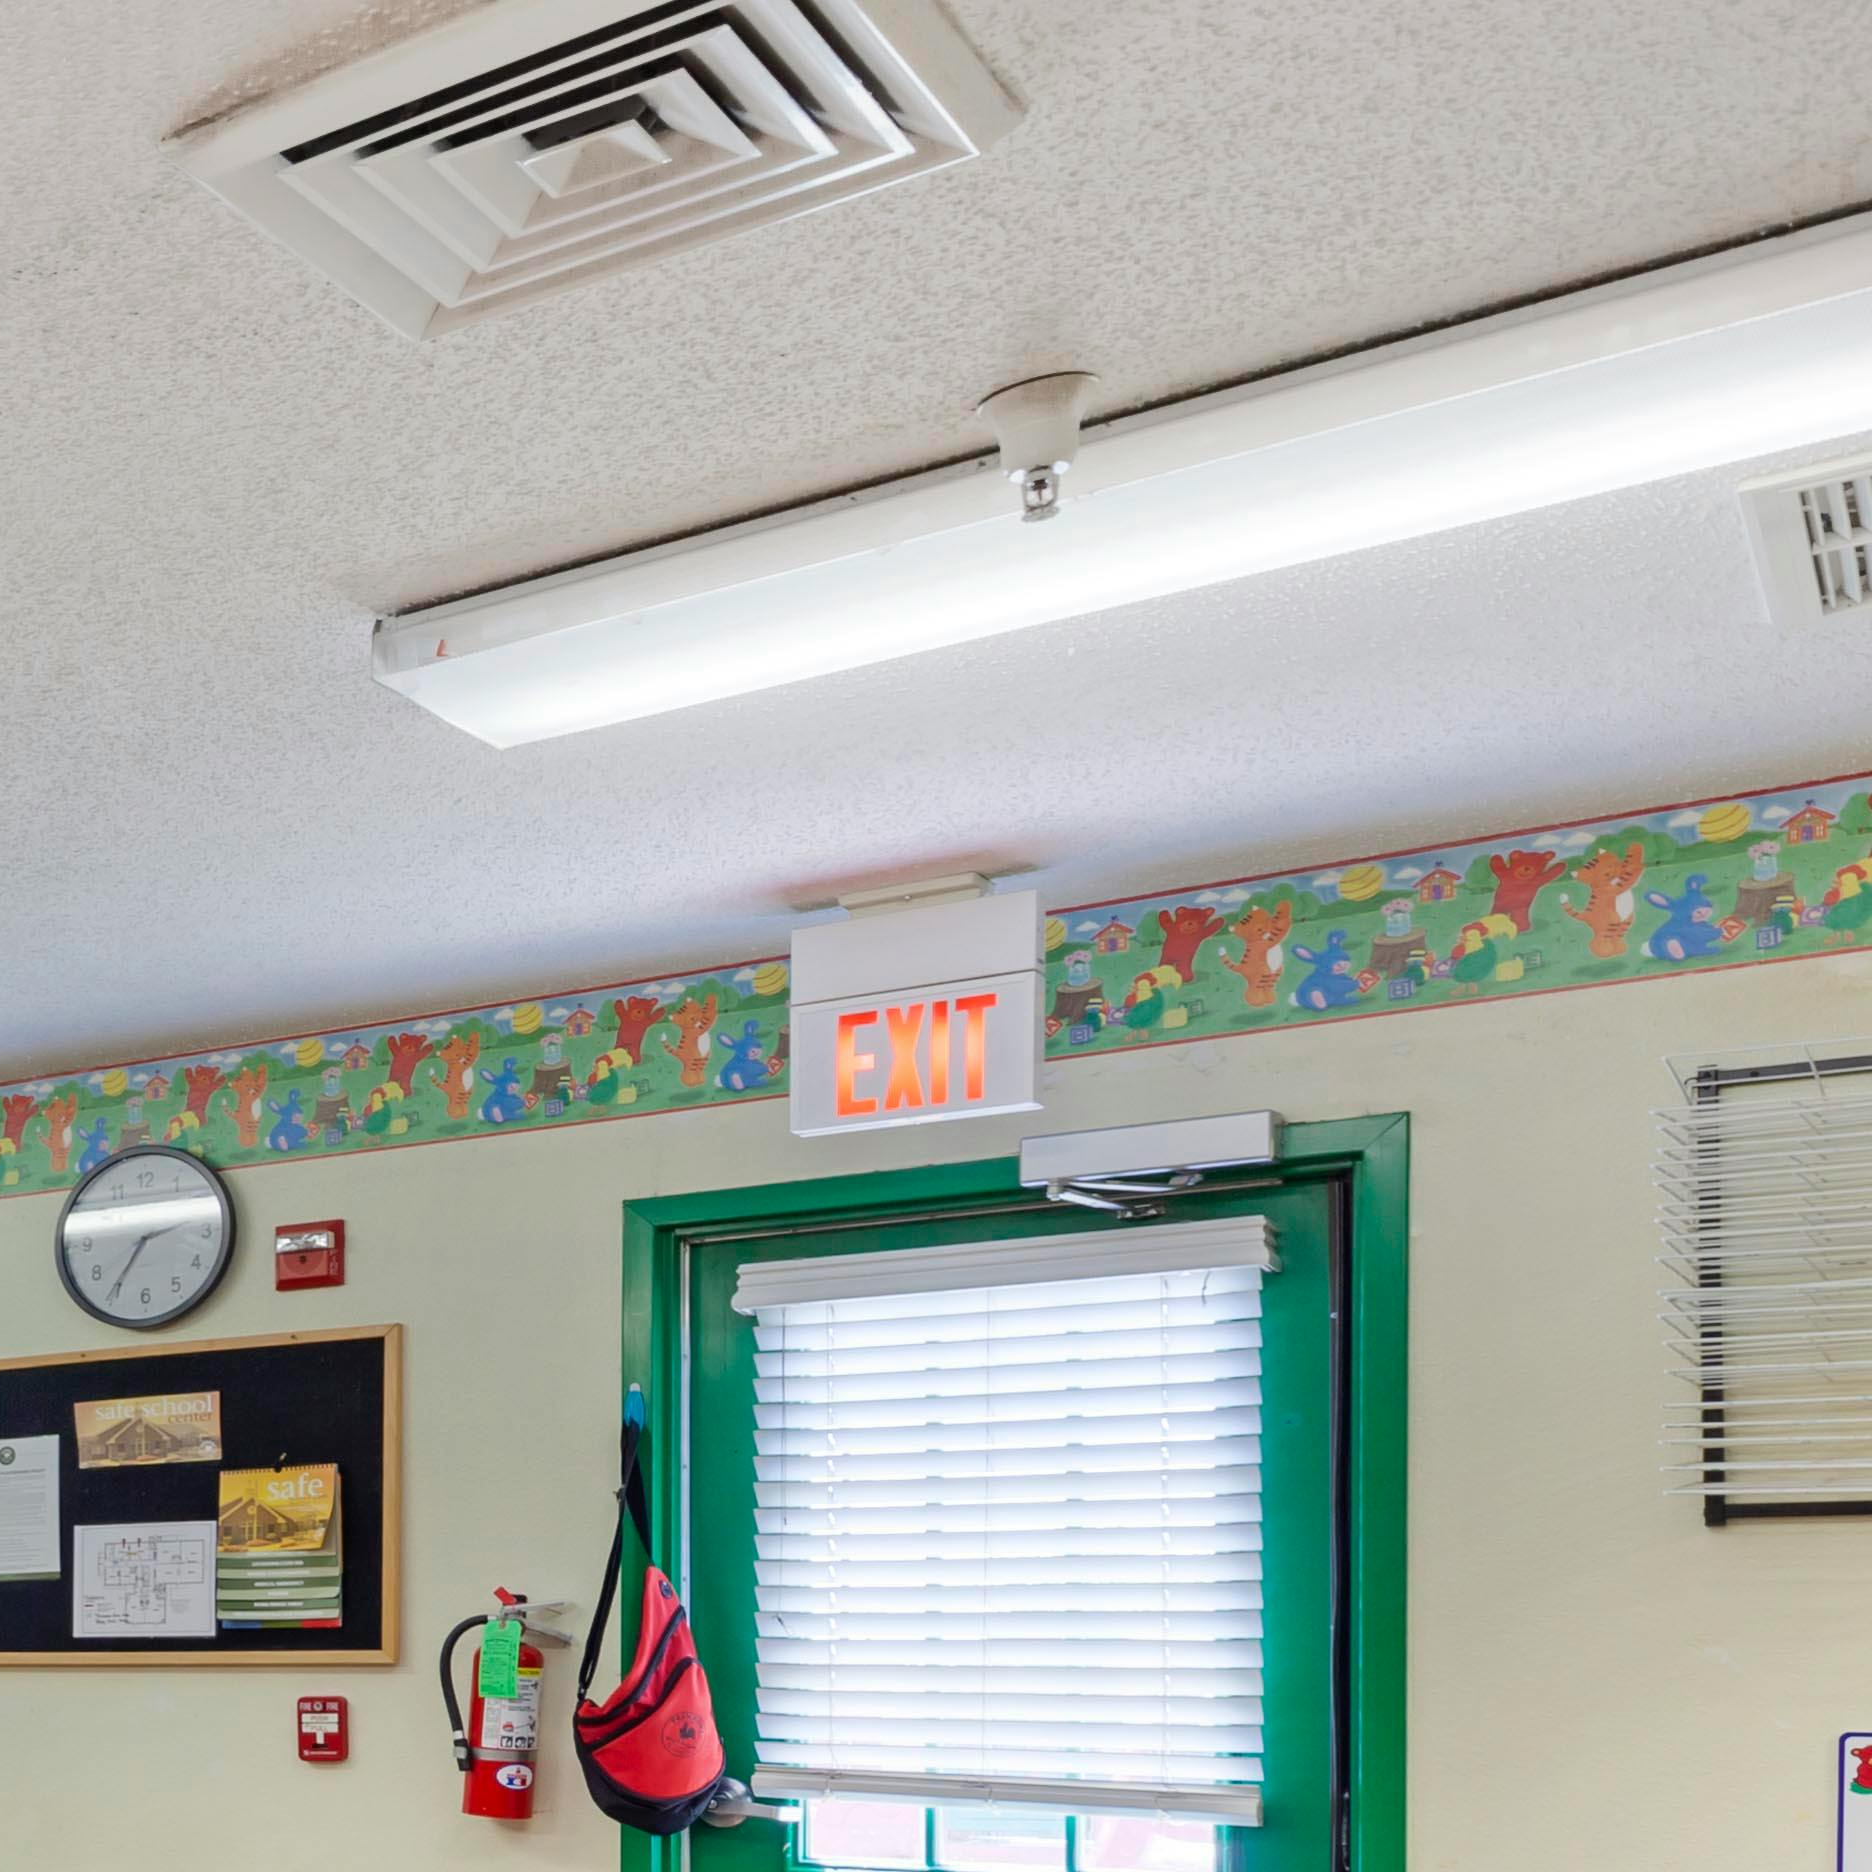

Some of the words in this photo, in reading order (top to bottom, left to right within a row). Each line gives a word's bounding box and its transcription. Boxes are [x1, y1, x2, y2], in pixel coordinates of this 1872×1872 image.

[836, 993, 998, 1117] EXIT
[136, 1171, 154, 1188] 12
[173, 1176, 181, 1193] 1
[110, 1184, 125, 1200] 11
[200, 1223, 212, 1239] 3
[81, 1237, 93, 1252] 9
[190, 1254, 201, 1270] 4
[92, 1264, 103, 1281] 8
[170, 1276, 182, 1293] 5
[140, 1287, 152, 1304] 6
[95, 1401, 135, 1421] safe
[142, 1395, 213, 1417] school
[167, 1412, 213, 1424] center
[266, 1472, 325, 1500] safe
